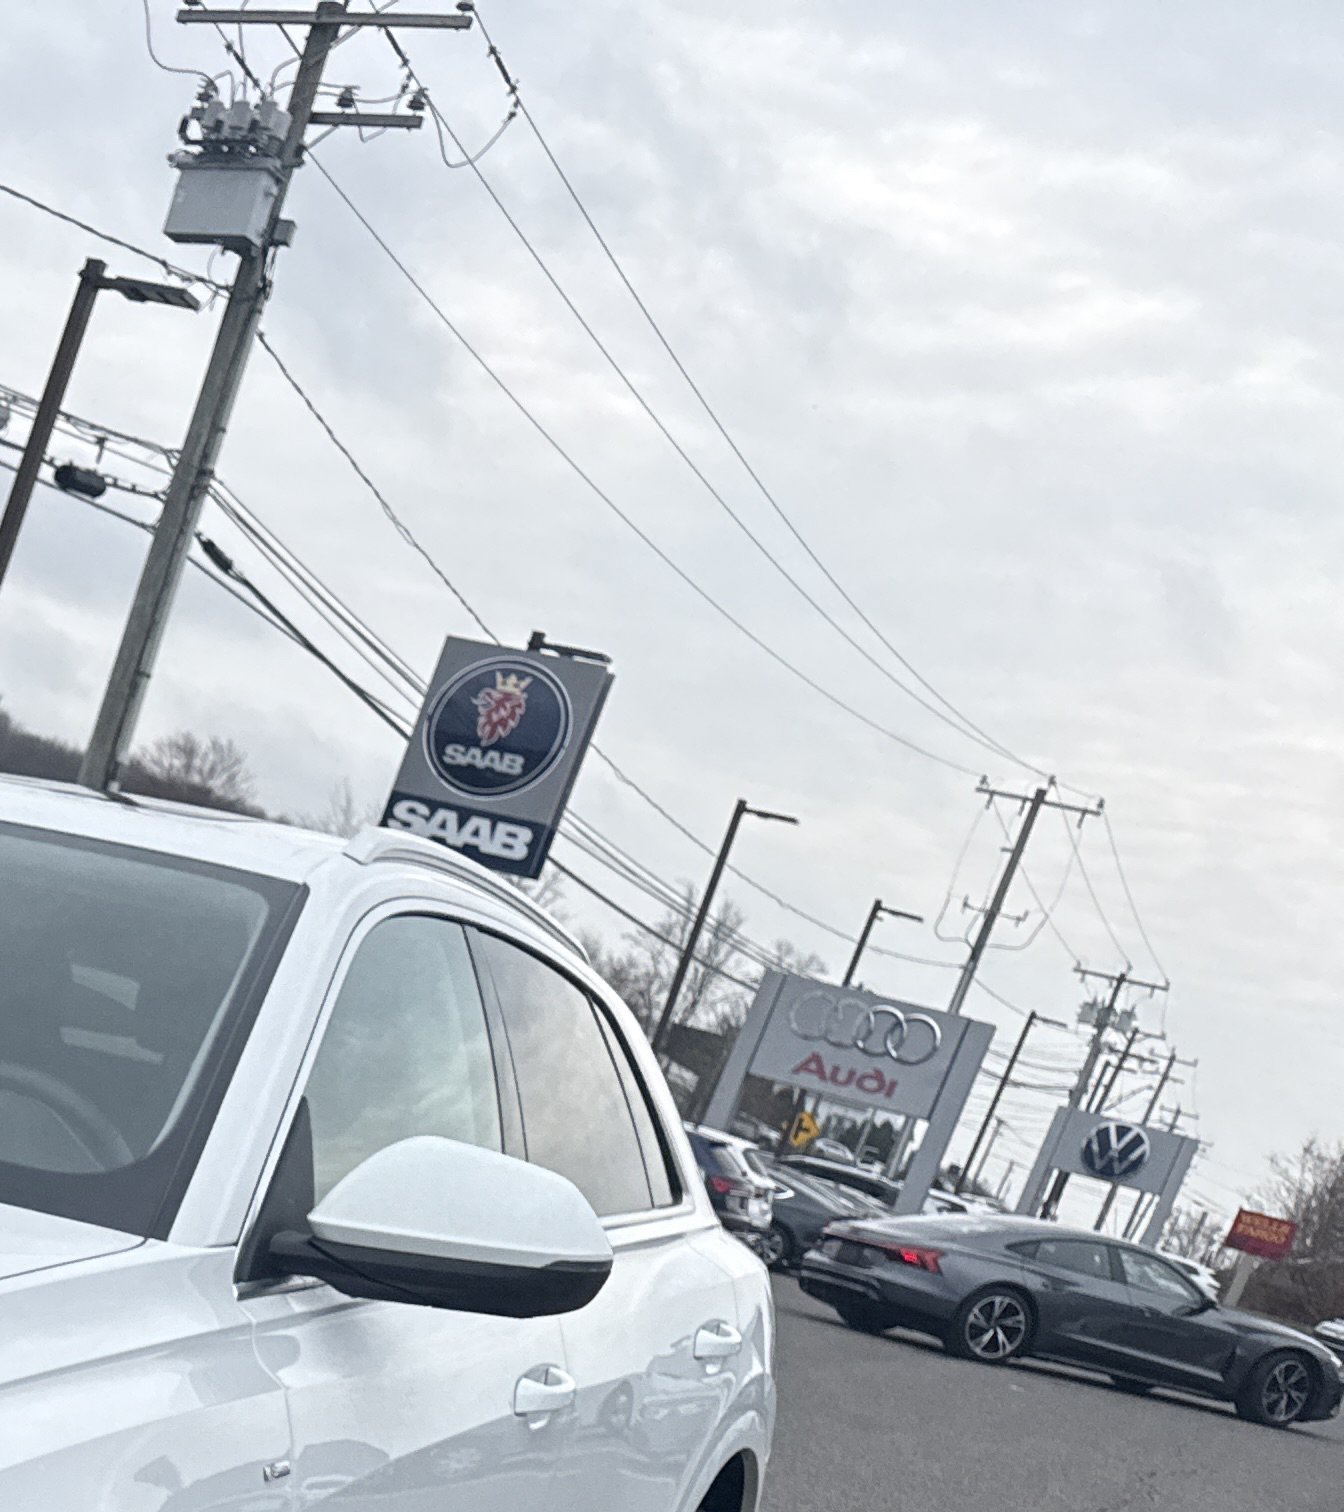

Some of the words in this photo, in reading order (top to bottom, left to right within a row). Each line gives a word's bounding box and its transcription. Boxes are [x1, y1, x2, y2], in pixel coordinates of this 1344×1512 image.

[443, 744, 525, 775] SAAB
[387, 799, 534, 861] SAAB
[792, 1050, 898, 1099] Audi
